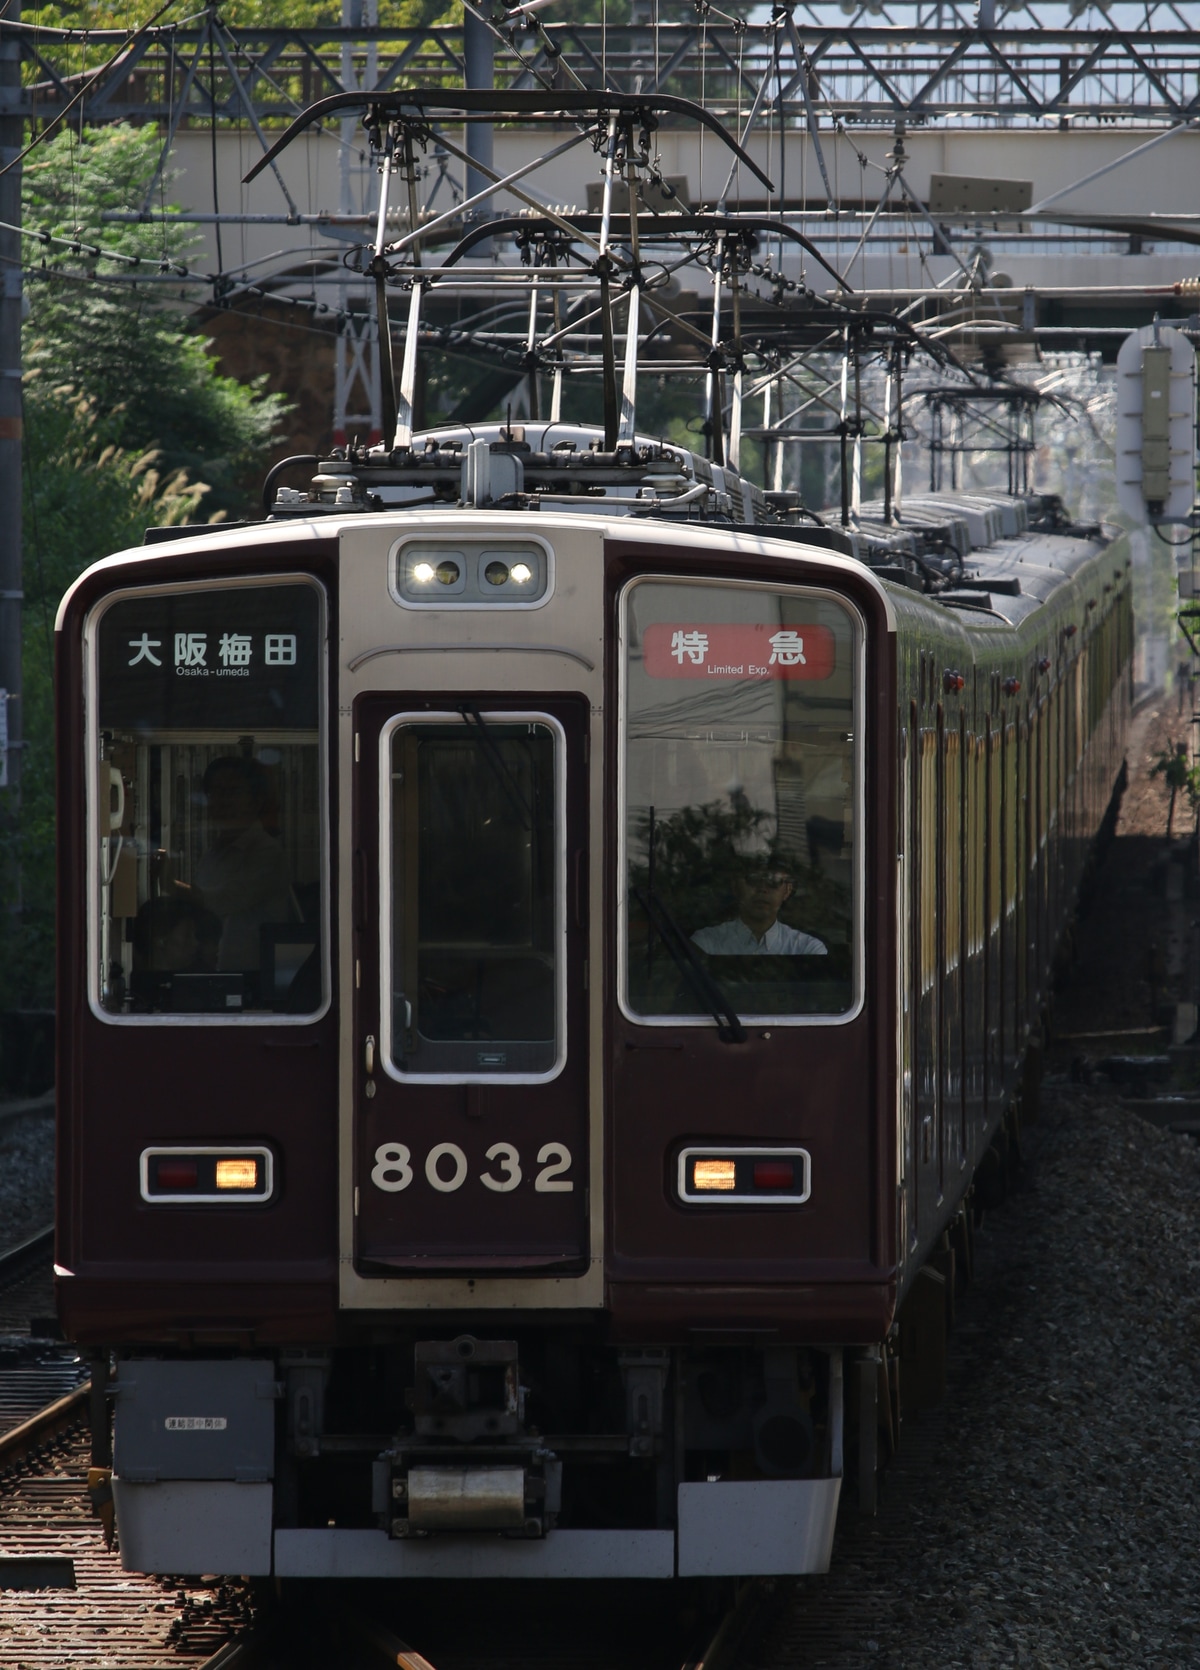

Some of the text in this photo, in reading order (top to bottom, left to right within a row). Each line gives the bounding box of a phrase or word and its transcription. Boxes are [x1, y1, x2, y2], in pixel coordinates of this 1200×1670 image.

[128, 632, 297, 666] 大阪梅田
[671, 630, 806, 664] 特急
[175, 666, 250, 677] Osaka-umeda
[707, 664, 770, 676] Limited Exp.
[370, 1141, 574, 1193] 8032
